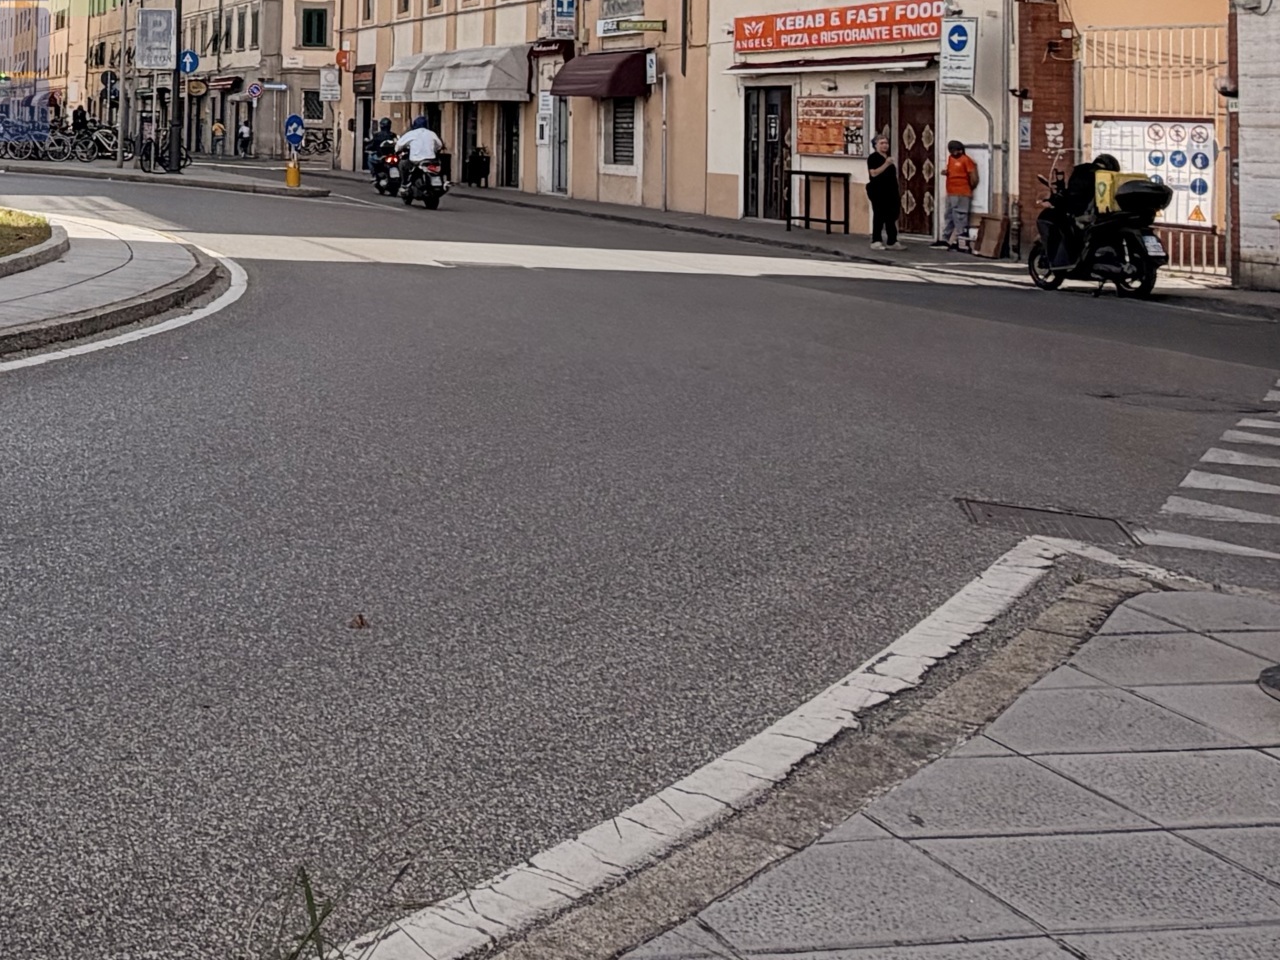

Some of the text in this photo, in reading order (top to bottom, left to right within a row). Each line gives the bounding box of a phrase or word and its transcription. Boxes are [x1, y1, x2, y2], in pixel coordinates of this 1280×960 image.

[776, 1, 945, 31] KEBAB & FAST FOOD
[735, 38, 774, 49] ANGELS
[781, 33, 809, 47] PIZZA
[820, 26, 890, 44] RISTORANTE
[892, 22, 938, 39] ETNICO
